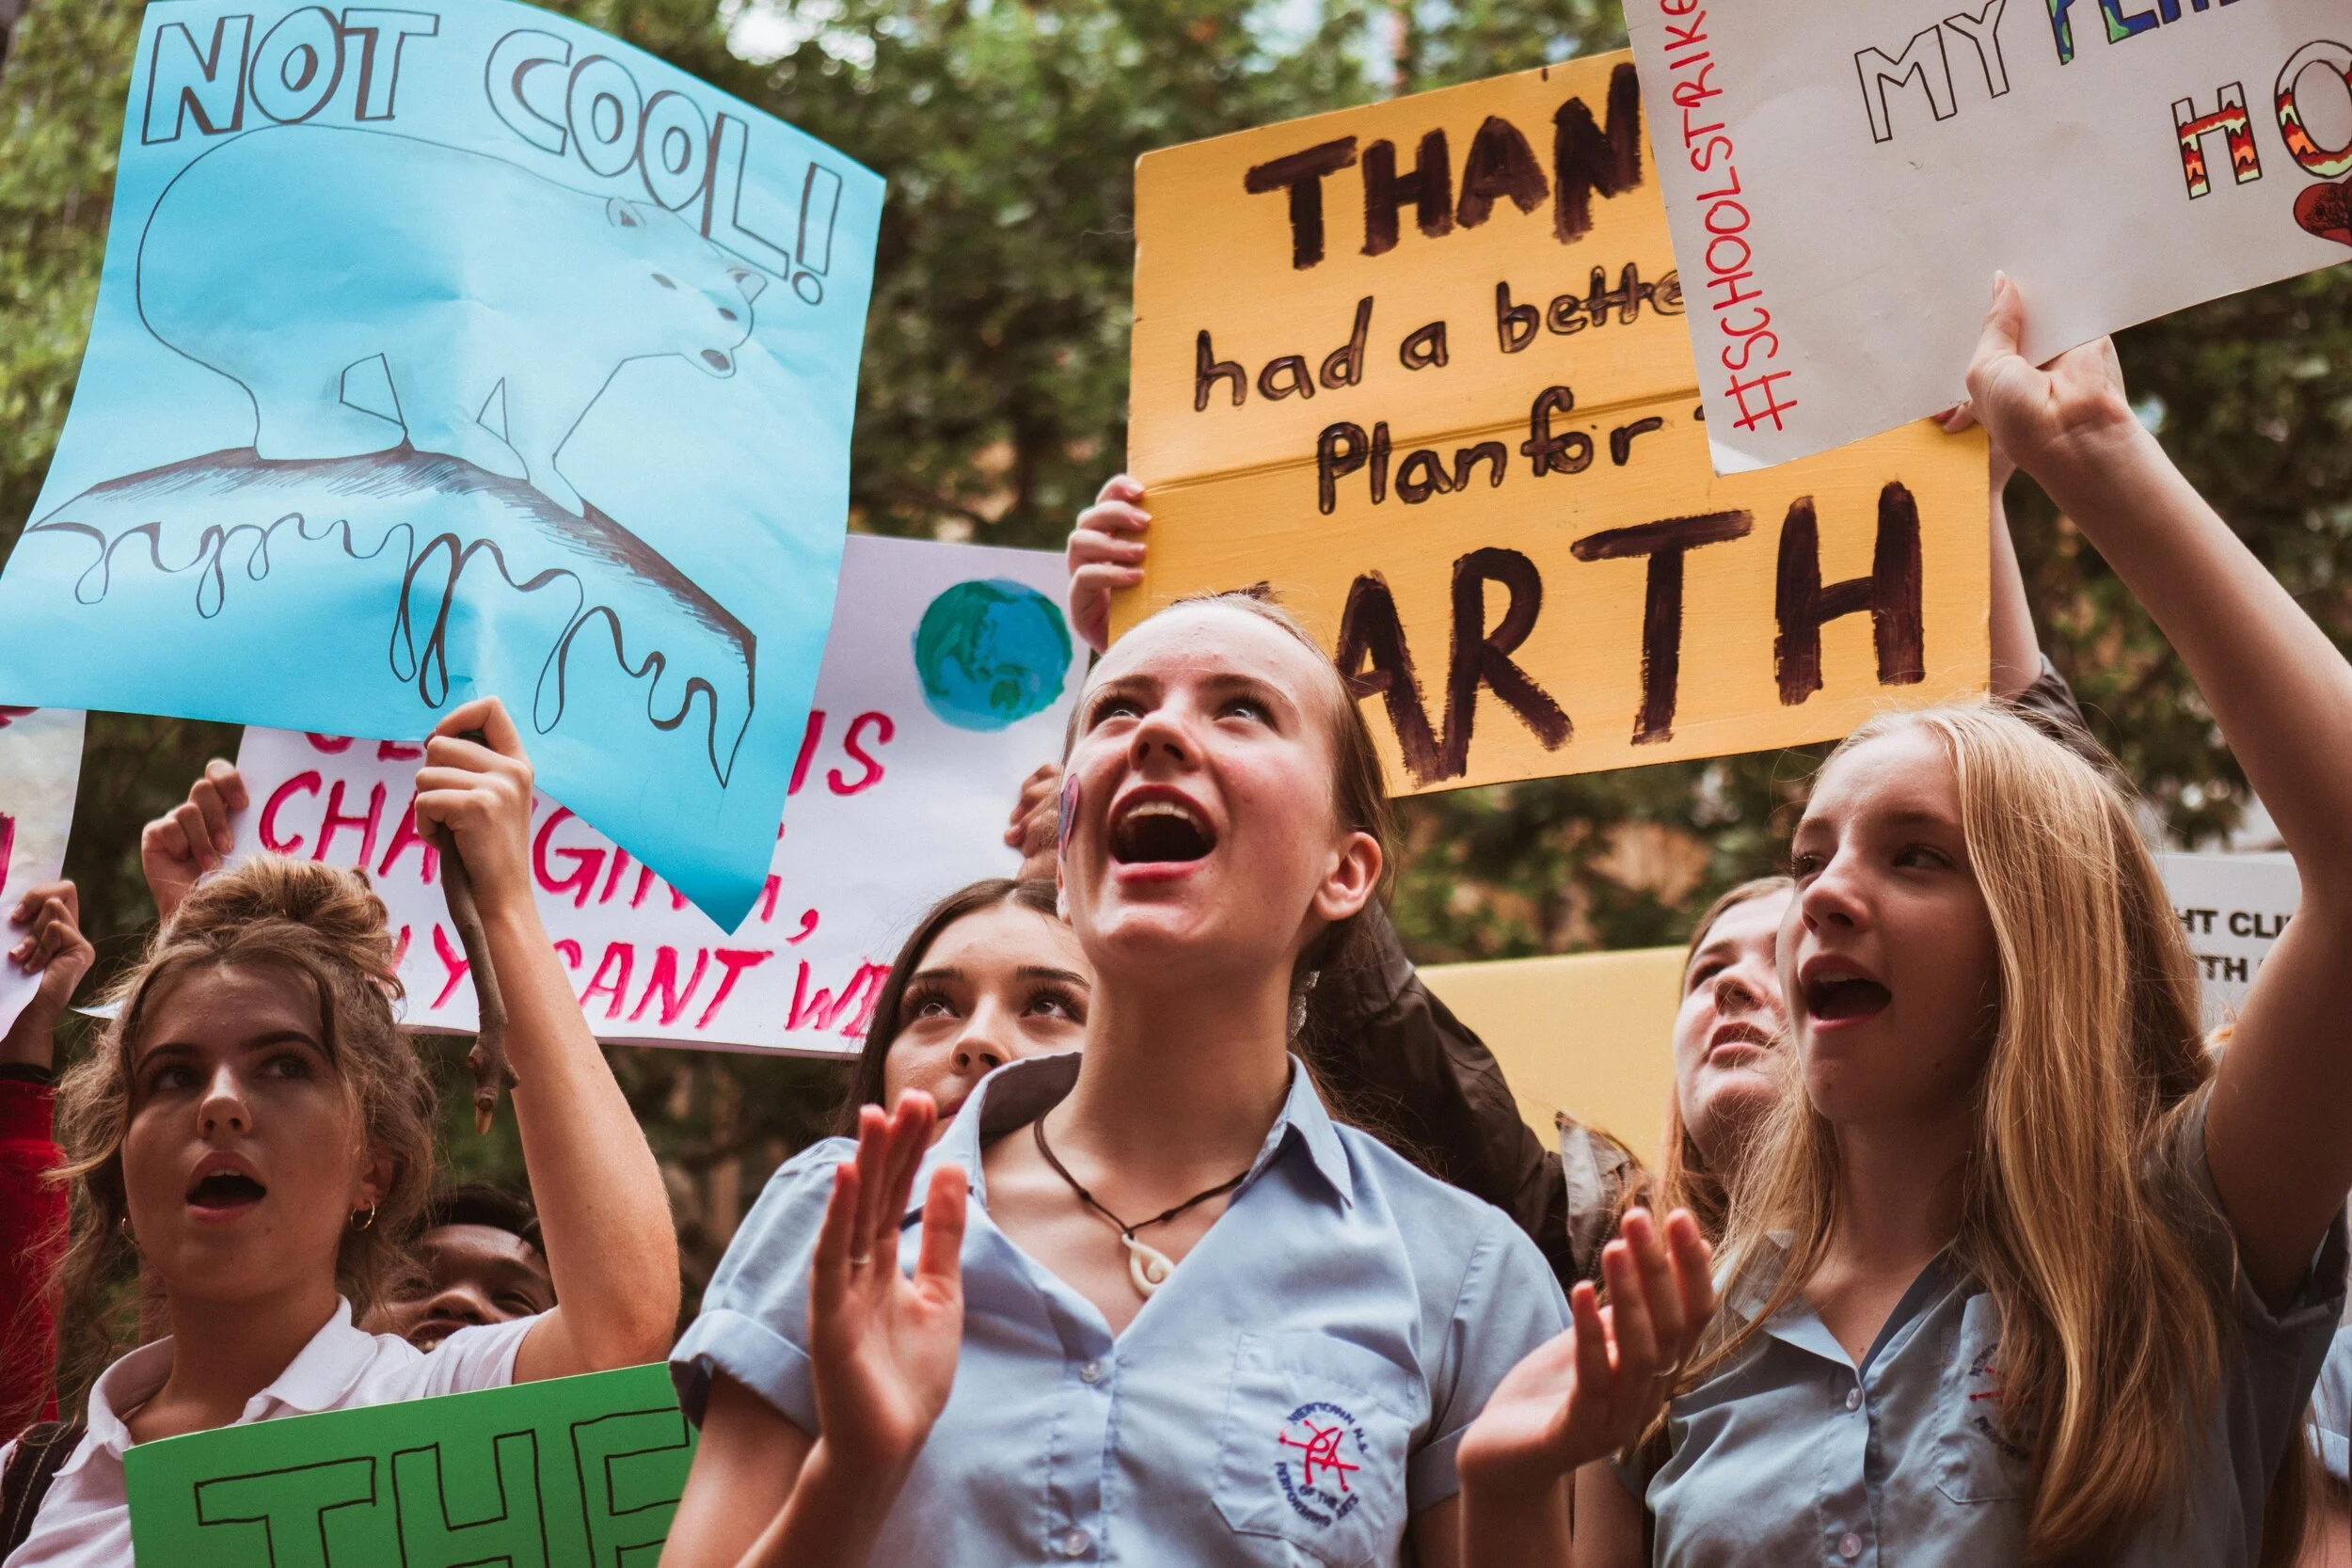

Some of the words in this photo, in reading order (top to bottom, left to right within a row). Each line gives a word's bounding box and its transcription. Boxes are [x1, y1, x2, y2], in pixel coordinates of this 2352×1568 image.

[1854, 0, 2010, 144] MY
[142, 6, 439, 145] NOT
[485, 29, 843, 306] COOL!
[1244, 61, 1644, 270] THAN
[1193, 295, 1374, 412] had
[1399, 321, 1450, 371] a
[1496, 262, 1685, 354] bette
[1520, 385, 1663, 476] for
[1171, 481, 1926, 788] ARTH
[787, 708, 896, 797] IS
[2228, 911, 2294, 939] CLI
[194, 1406, 690, 1568] THE
